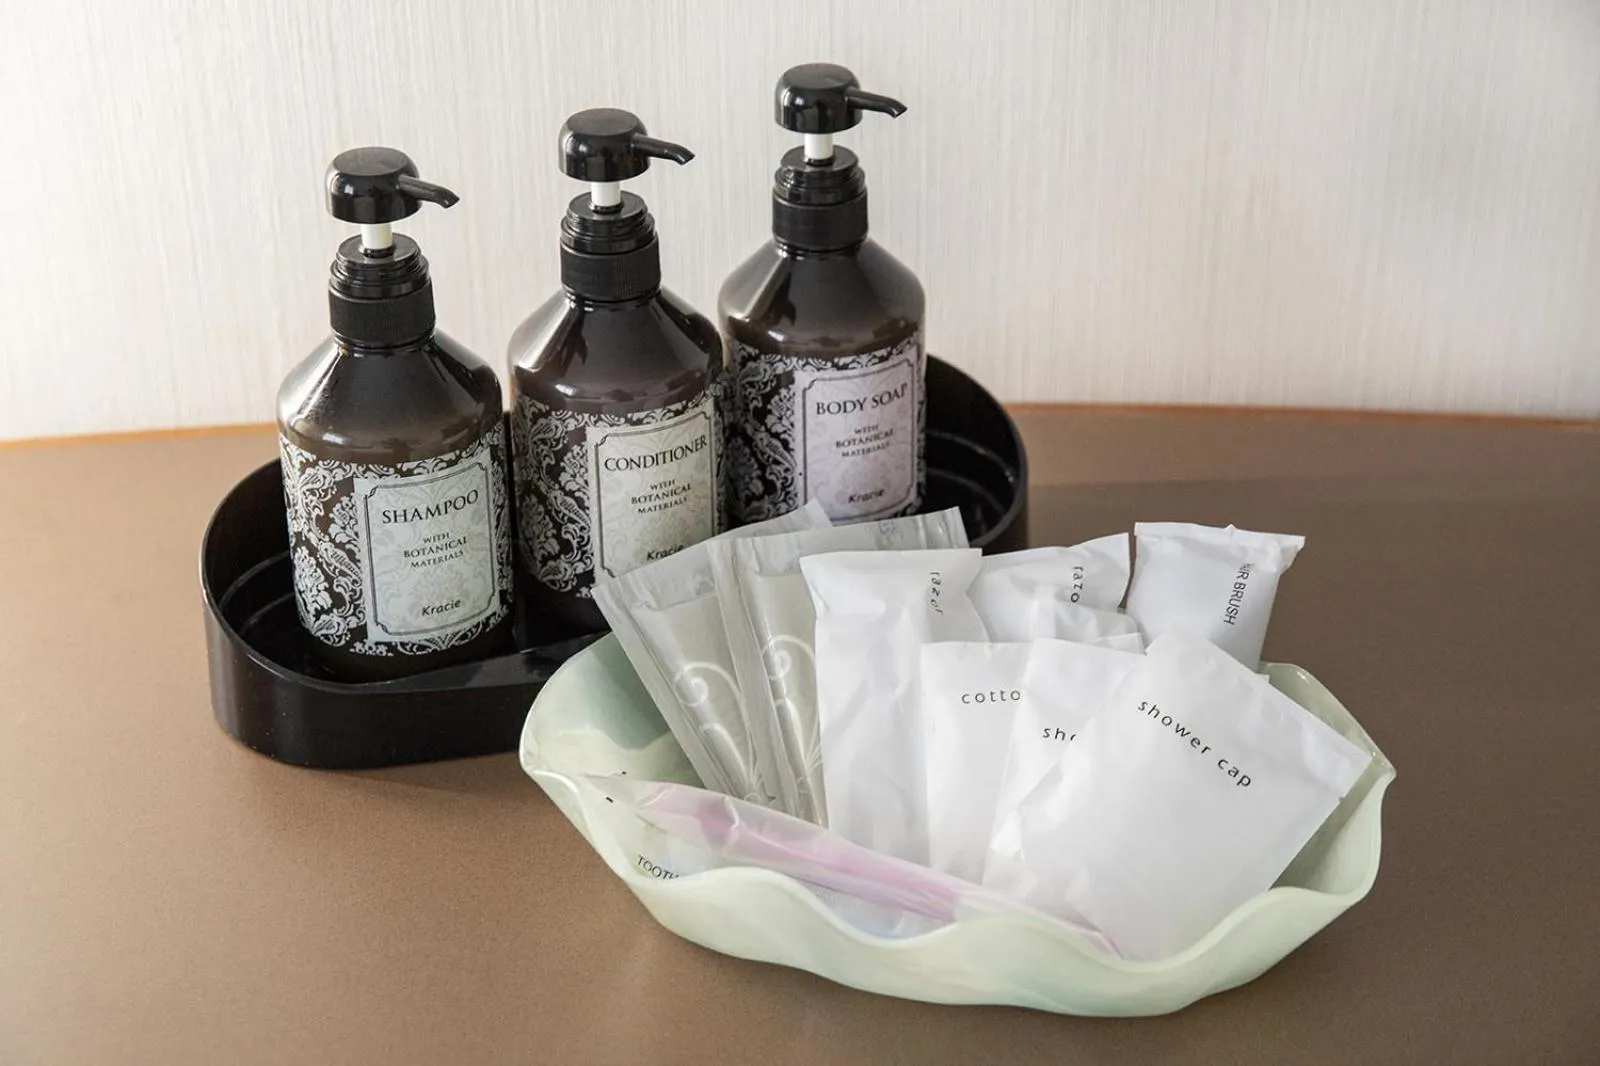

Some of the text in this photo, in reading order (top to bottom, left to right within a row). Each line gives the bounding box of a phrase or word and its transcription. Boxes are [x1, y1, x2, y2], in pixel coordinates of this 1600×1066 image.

[816, 383, 908, 415] BODY SOAP
[836, 429, 894, 448] BOTANICAL
[854, 424, 879, 434] WITH
[604, 434, 708, 471] CONDITIONER
[631, 483, 692, 505] BOTANICAL
[650, 479, 676, 490] WITH
[382, 489, 479, 524] SHAMPOO
[638, 497, 688, 514] MATERIALS
[403, 536, 468, 559] BOTANICAL
[423, 532, 450, 544] WITH
[411, 550, 464, 569] MATERIALS
[421, 599, 461, 617] Kracie
[1223, 582, 1247, 626] BRUSH
[961, 689, 1021, 704] cotto
[1137, 701, 1252, 787] shower cap
